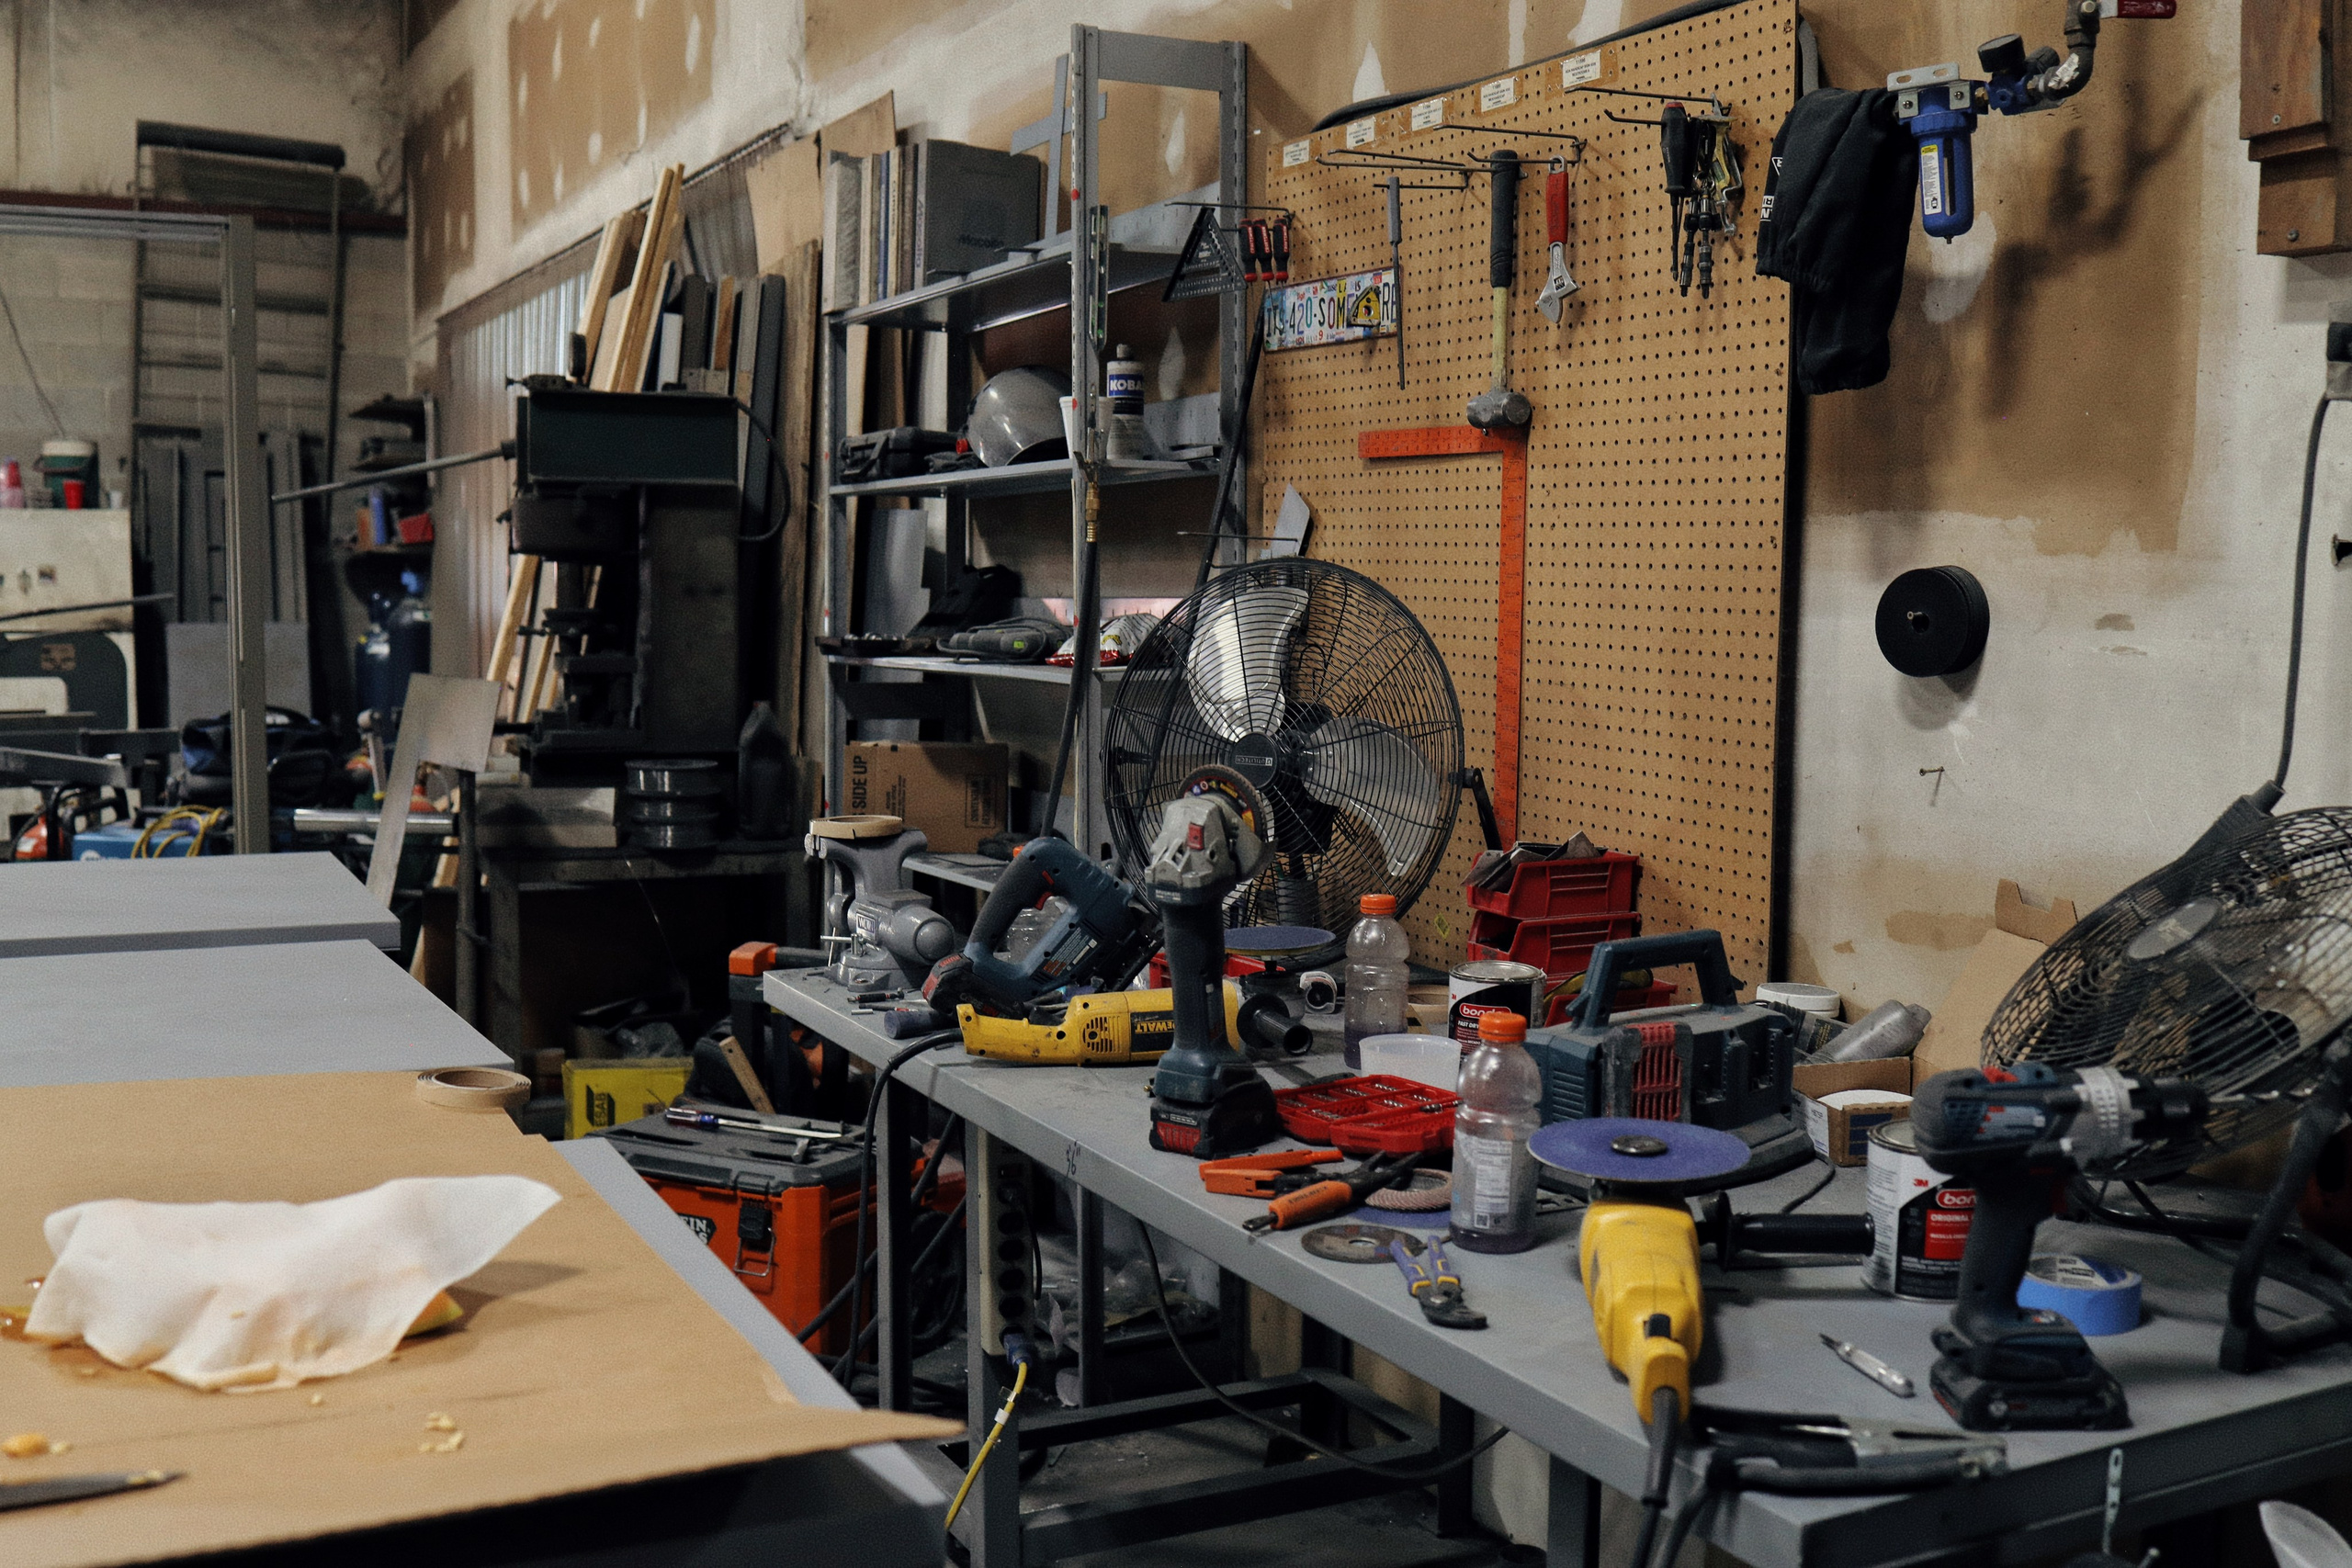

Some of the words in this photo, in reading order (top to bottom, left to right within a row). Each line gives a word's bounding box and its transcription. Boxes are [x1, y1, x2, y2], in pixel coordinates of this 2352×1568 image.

[854, 756, 867, 774] UP
[853, 778, 867, 808] SIDE
[1136, 1021, 1175, 1034] EWALT
[595, 1092, 606, 1127] ESAB
[1913, 1179, 1928, 1188] 3M
[1930, 1213, 1969, 1222] ORIGINAL
